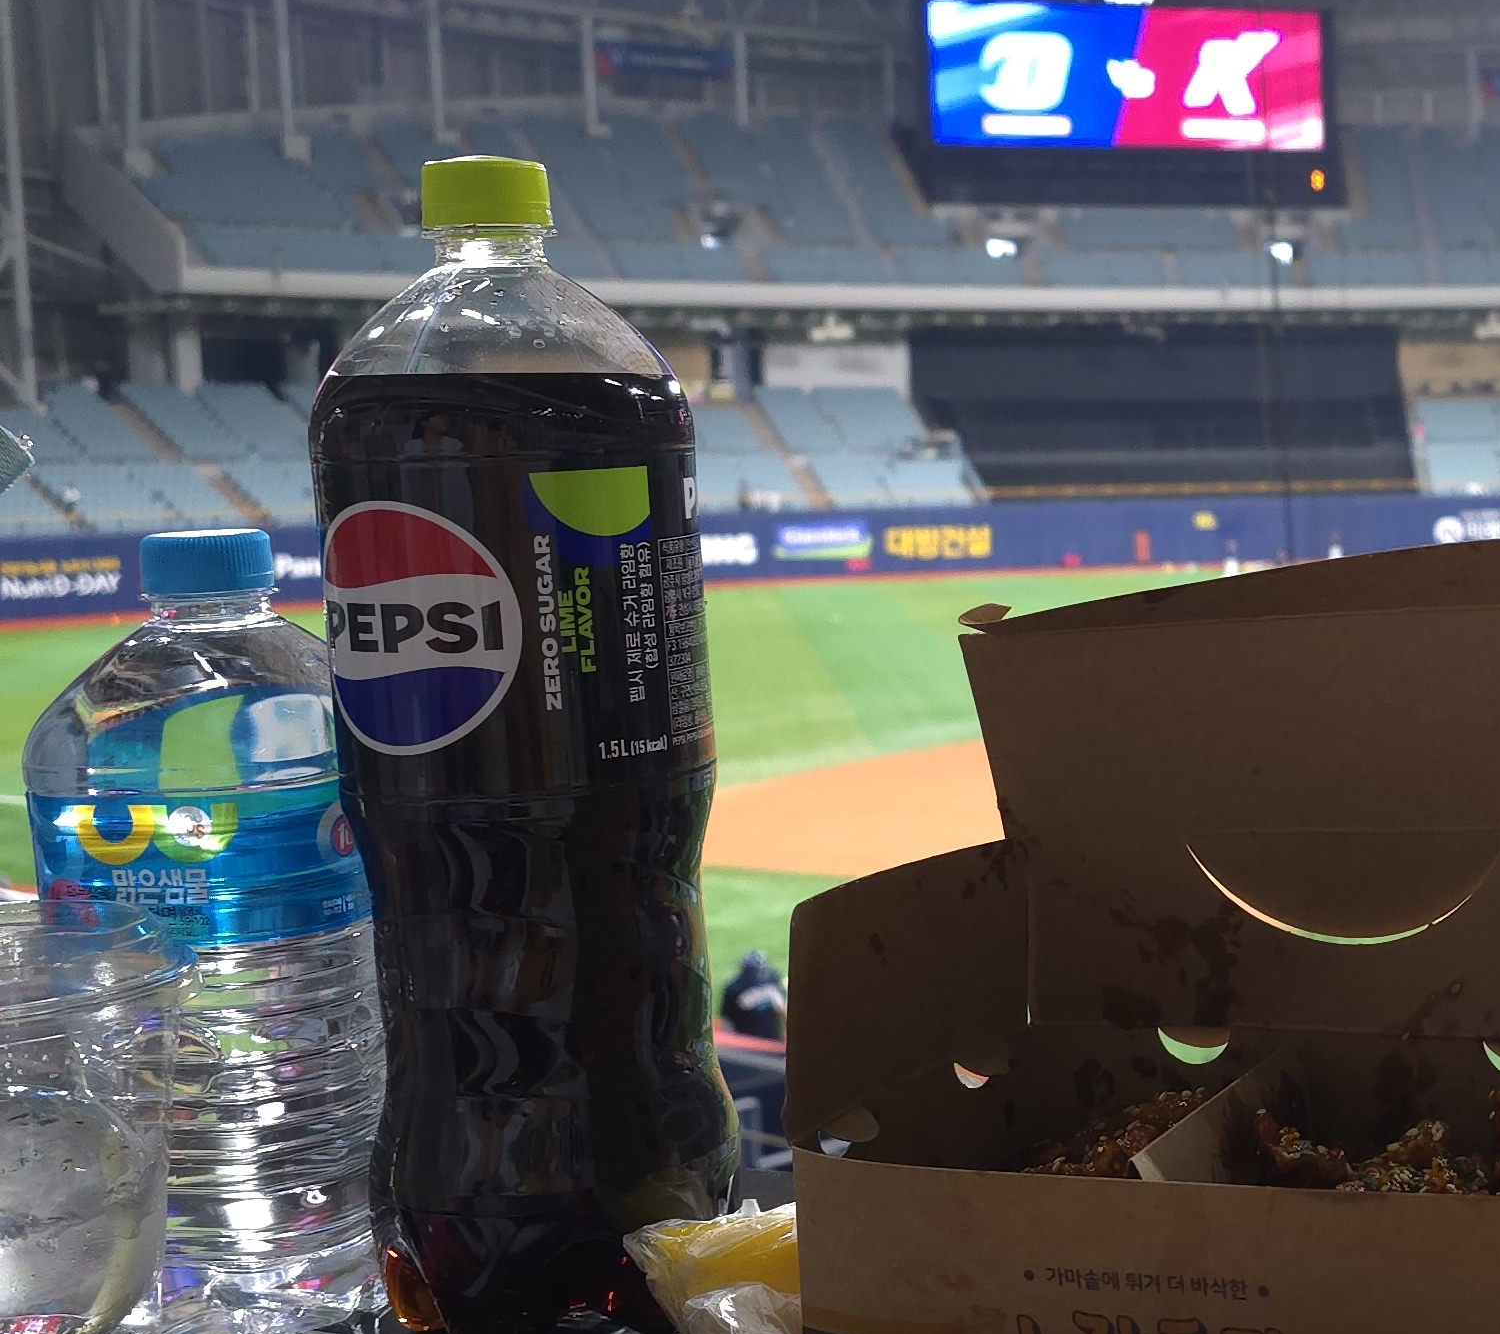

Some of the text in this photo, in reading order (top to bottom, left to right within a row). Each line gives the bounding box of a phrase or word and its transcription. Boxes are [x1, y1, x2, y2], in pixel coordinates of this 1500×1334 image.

[326, 600, 504, 654] PEPSI
[534, 534, 563, 711] ZERO SUGAR
[557, 589, 578, 653] LIME
[574, 566, 597, 673] FLAVOR
[619, 543, 646, 703] 펩시 제로 슈거 라임향
[637, 540, 660, 670] (합성 라임향 함유)
[111, 868, 209, 905] 맑은샘물
[1046, 1267, 1249, 1301] 가마솥에 튀겨 더 바삭한
